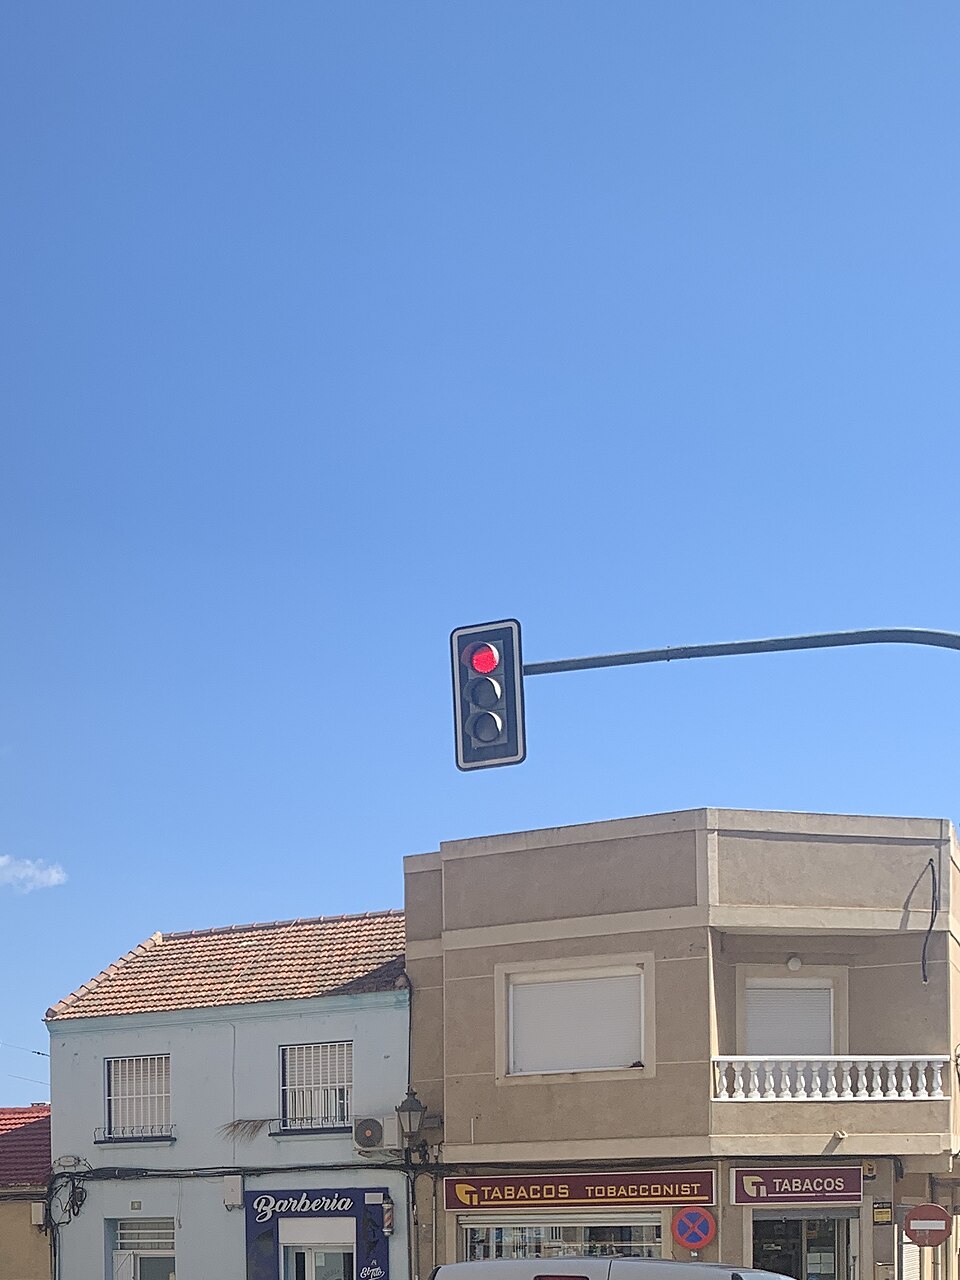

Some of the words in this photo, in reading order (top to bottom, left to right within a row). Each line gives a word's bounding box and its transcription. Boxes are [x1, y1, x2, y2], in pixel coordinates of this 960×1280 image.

[480, 1184, 569, 1200] TABACOS
[585, 1183, 701, 1197] TOBACCONIST
[771, 1177, 845, 1192] TABACOS
[253, 1192, 353, 1222] Barberia
